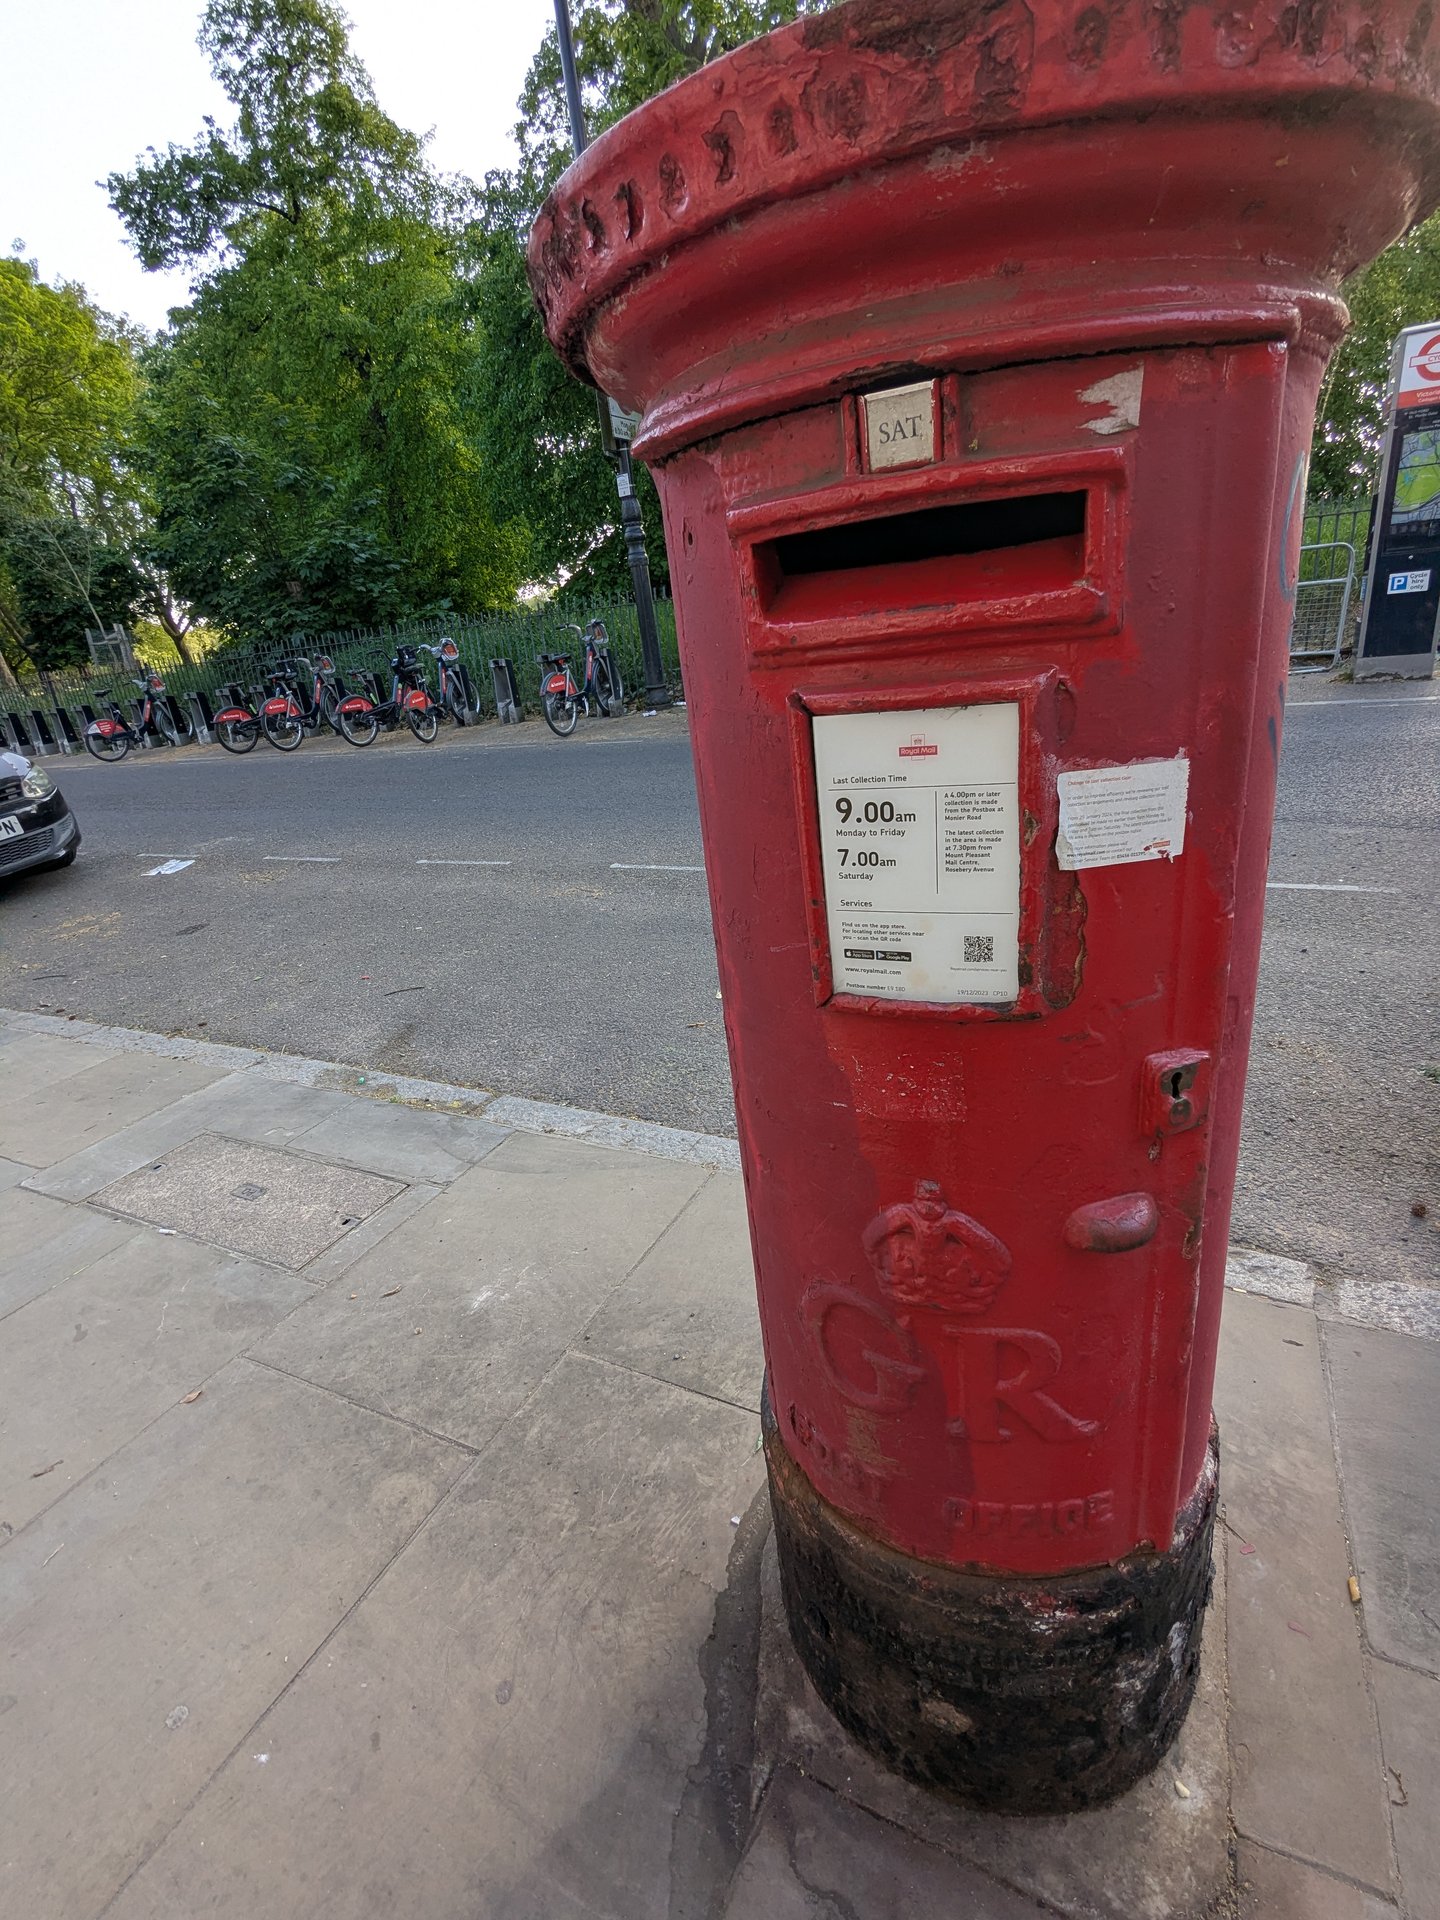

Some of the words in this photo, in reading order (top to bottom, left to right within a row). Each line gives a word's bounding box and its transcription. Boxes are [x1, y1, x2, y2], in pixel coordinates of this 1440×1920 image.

[900, 747, 920, 756] Royal
[920, 746, 937, 754] Mail
[832, 777, 849, 785] Last
[850, 775, 886, 784] Collection
[887, 774, 907, 782] Time
[950, 791, 976, 799] 4.00pm
[835, 797, 916, 824] 9.00am
[835, 829, 867, 837] Monday
[880, 828, 906, 837] Friday
[975, 828, 1005, 836] collection
[952, 844, 977, 852] 7.30pm
[837, 848, 897, 867] 7.00am
[945, 866, 972, 874] Rosebery
[838, 871, 874, 881] Saturday
[840, 899, 873, 908] Services
[851, 928, 873, 936] locating
[844, 967, 902, 976] www.royalmail.com
[845, 981, 866, 989] Postbox
